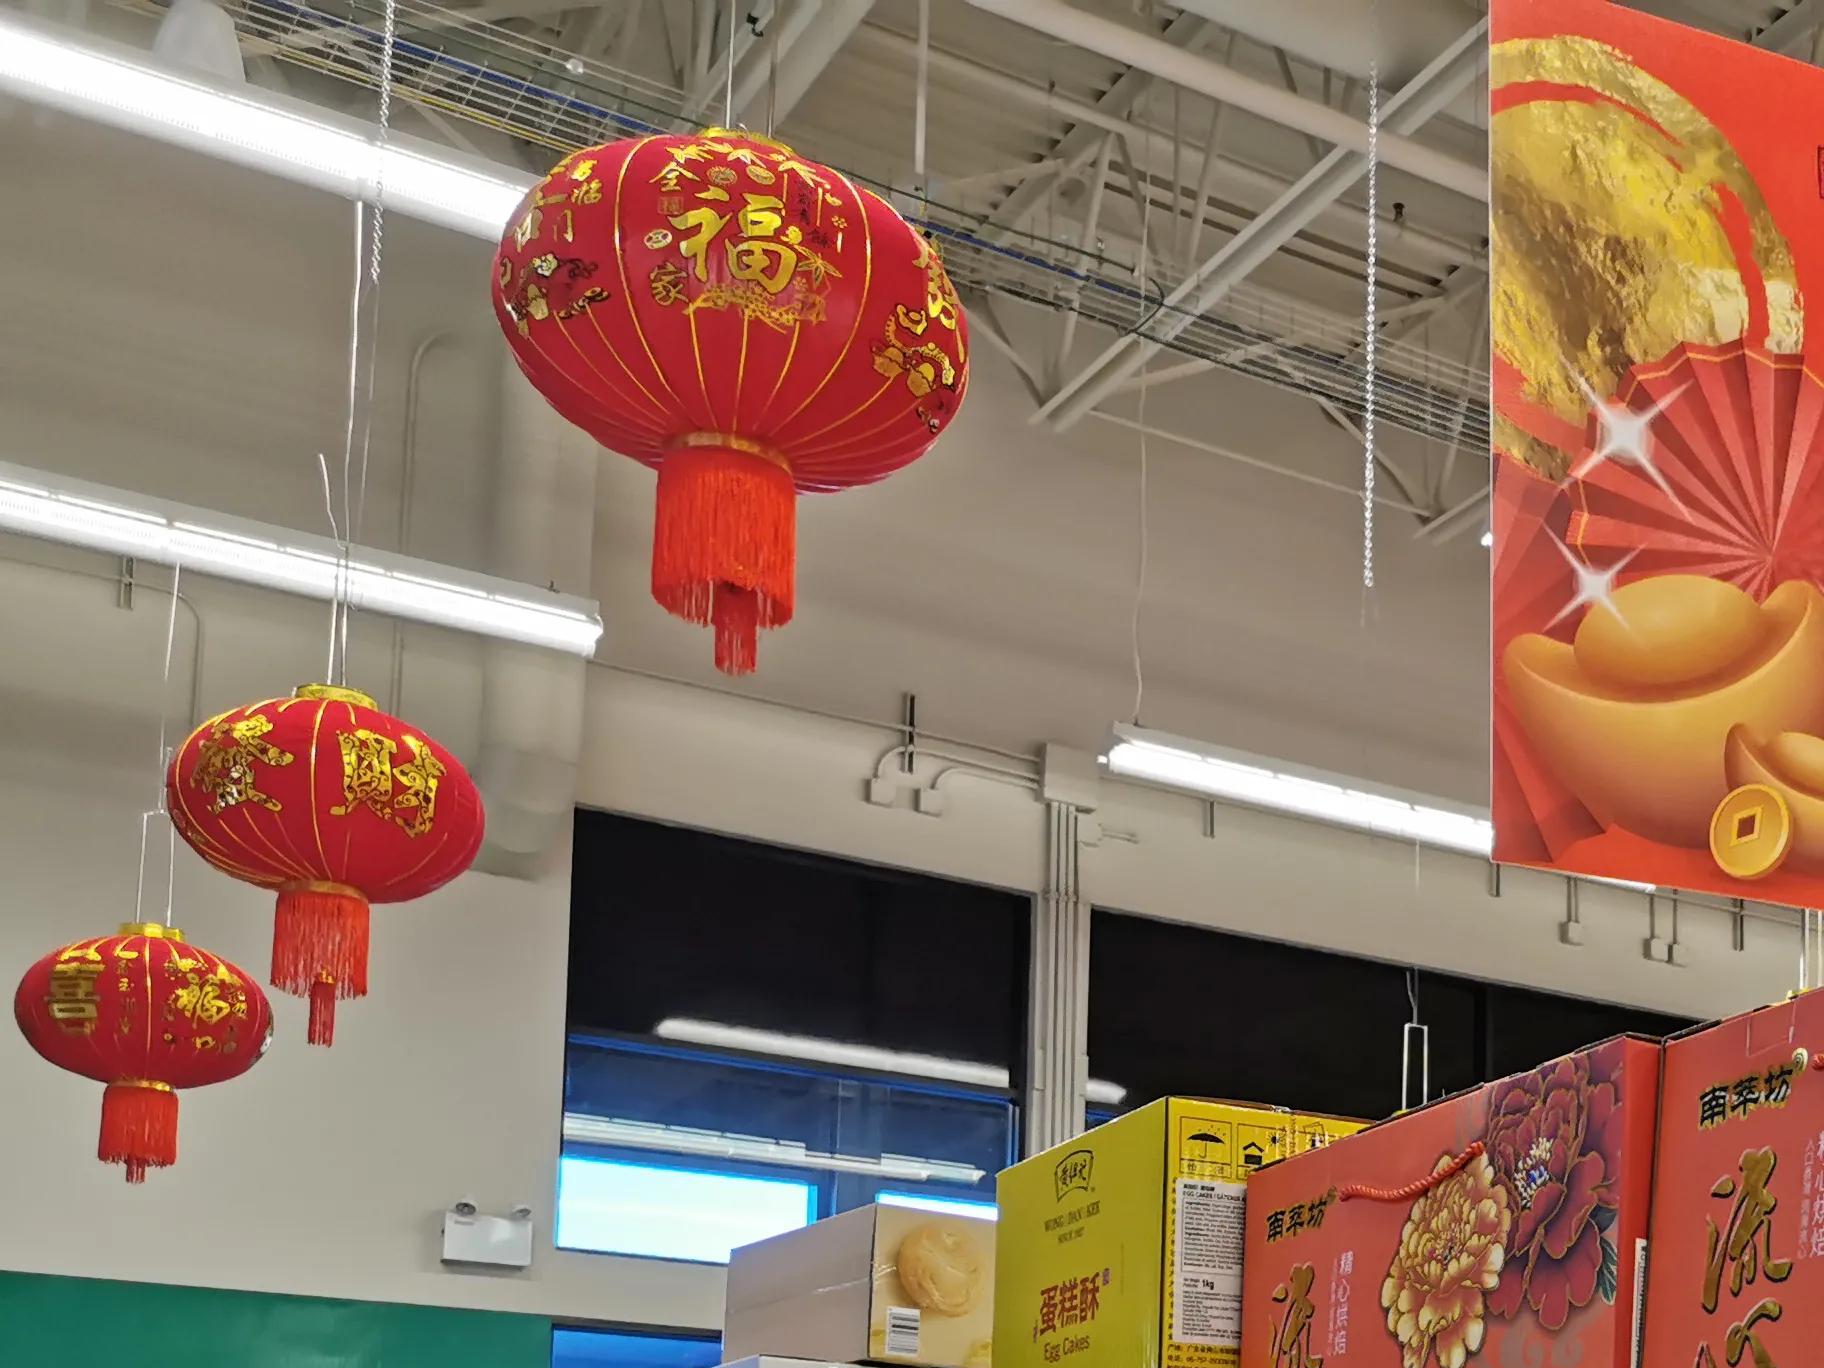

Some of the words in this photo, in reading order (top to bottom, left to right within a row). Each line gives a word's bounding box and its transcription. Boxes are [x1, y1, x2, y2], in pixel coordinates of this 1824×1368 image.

[667, 184, 797, 294] 福
[1039, 1272, 1100, 1337] 蛋糕酥
[1202, 1279, 1215, 1291] 1kg
[1043, 1341, 1061, 1364] Egg
[1062, 1334, 1091, 1355] Cakes
